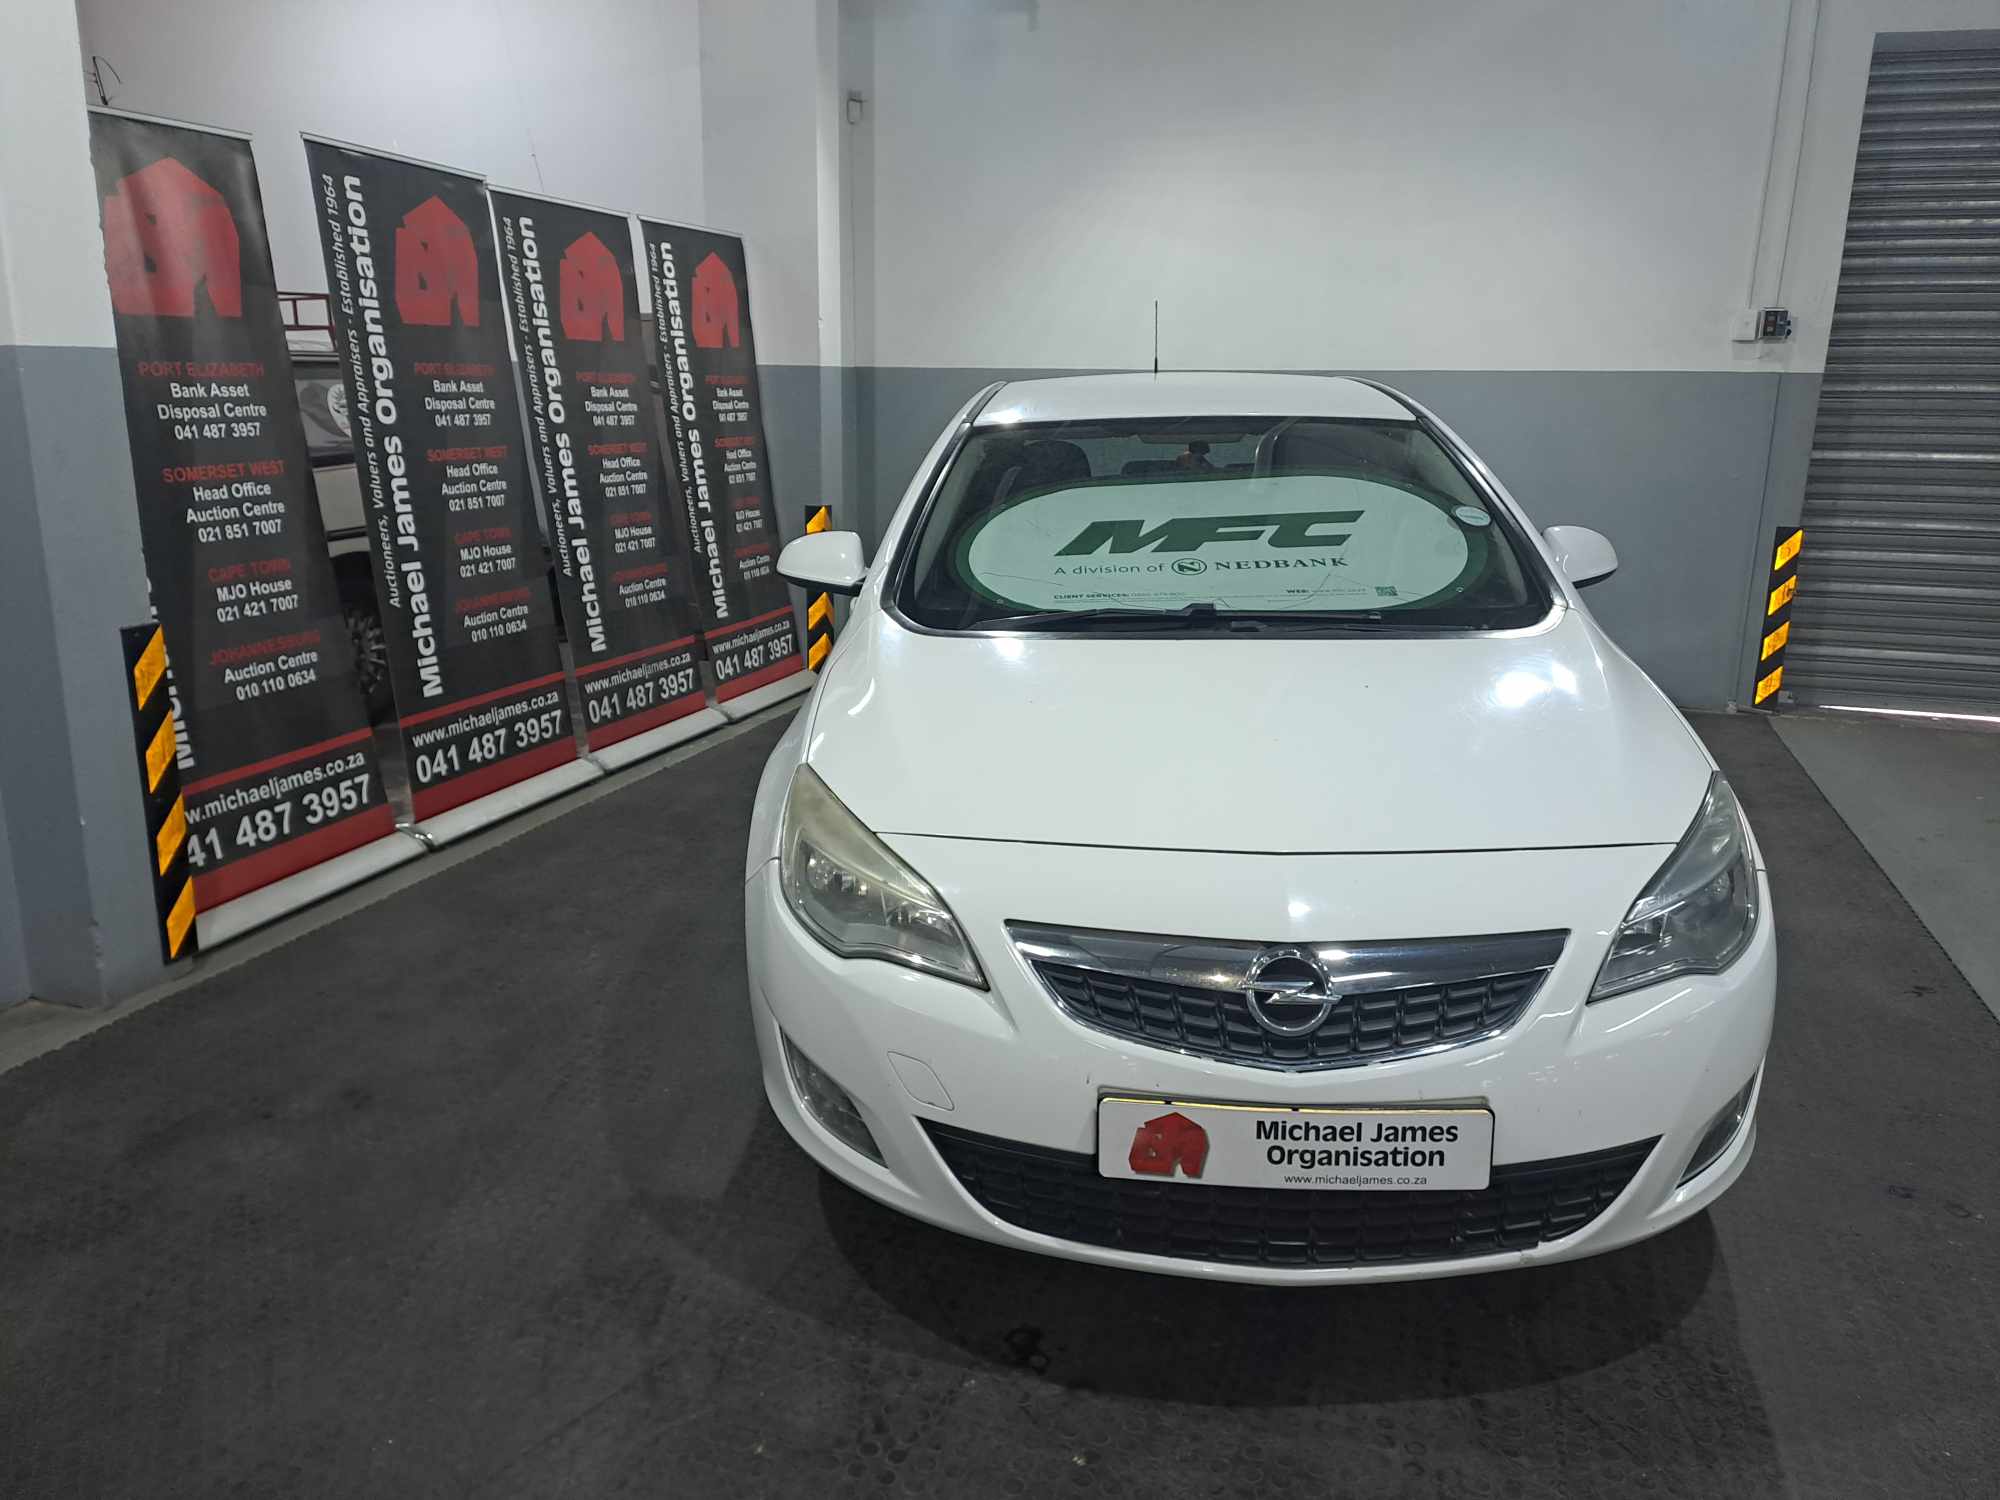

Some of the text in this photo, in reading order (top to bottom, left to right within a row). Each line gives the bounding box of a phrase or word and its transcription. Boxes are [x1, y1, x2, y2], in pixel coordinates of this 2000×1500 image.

[323, 174, 338, 216] 1964
[504, 217, 518, 251] 1964
[331, 220, 354, 314] Established
[509, 254, 529, 332] Established
[652, 275, 669, 343] Established
[137, 361, 265, 378] PORT ELIZABETH
[346, 328, 371, 412] Appraisers
[525, 343, 544, 415] Appraisers
[663, 352, 679, 414] Appraisers
[170, 382, 250, 398] Bank Asset
[433, 379, 484, 393] Bank Asset
[157, 402, 267, 421] Disposal Centre
[424, 397, 496, 412] Disposal Centre
[434, 413, 491, 427] 041 487 3957
[174, 422, 261, 440] 041 487 3957
[343, 175, 444, 698] Michael James Organisation
[362, 415, 375, 447] and
[519, 217, 608, 654] Michael James Organisation
[533, 417, 546, 445] and
[660, 242, 729, 619] Michael James Organisation
[672, 416, 683, 438] and
[162, 460, 285, 483] SOMERSET WEST
[446, 462, 498, 478] Head Office
[544, 446, 558, 494] Valuers
[676, 438, 690, 483] Valuers
[192, 481, 272, 502] Head Office
[365, 450, 385, 508] Valuers
[441, 479, 507, 496] Auction Centre
[186, 501, 285, 524] Auction Centre
[449, 494, 505, 512] 021 851 7007
[198, 519, 282, 543] 021 851 7007
[684, 486, 703, 554] Auctioneers,
[1054, 510, 1365, 556] MFC
[460, 543, 513, 561] MJO House
[552, 498, 573, 576] Auctioneers,
[377, 514, 401, 608] Auctioneers,
[459, 557, 516, 578] 021 421 7007
[1054, 557, 1350, 576] A division of NEDBANK
[216, 579, 293, 602] MJO House
[619, 581, 643, 596] Auction
[216, 595, 299, 623] 021 421 7007
[463, 603, 529, 628] Auction Centre
[471, 620, 527, 643] 010 110 0634
[211, 631, 321, 664] JOHANNES
[715, 634, 793, 680] 041 487 3957
[224, 651, 318, 684] Auction Centre
[585, 652, 691, 694] www.michaeljames.co.za
[236, 669, 316, 700] 010 110 0634
[588, 668, 694, 725] 041 487 3957
[412, 689, 559, 749] www.michaeljames.co.za
[416, 709, 563, 784] 041 487 3957
[235, 801, 294, 849] 487
[302, 773, 371, 826] 3957
[1256, 1120, 1458, 1142] Michael James
[1266, 1145, 1445, 1169] Organisation
[1283, 1174, 1427, 1187] www.michaeljames.co.za
